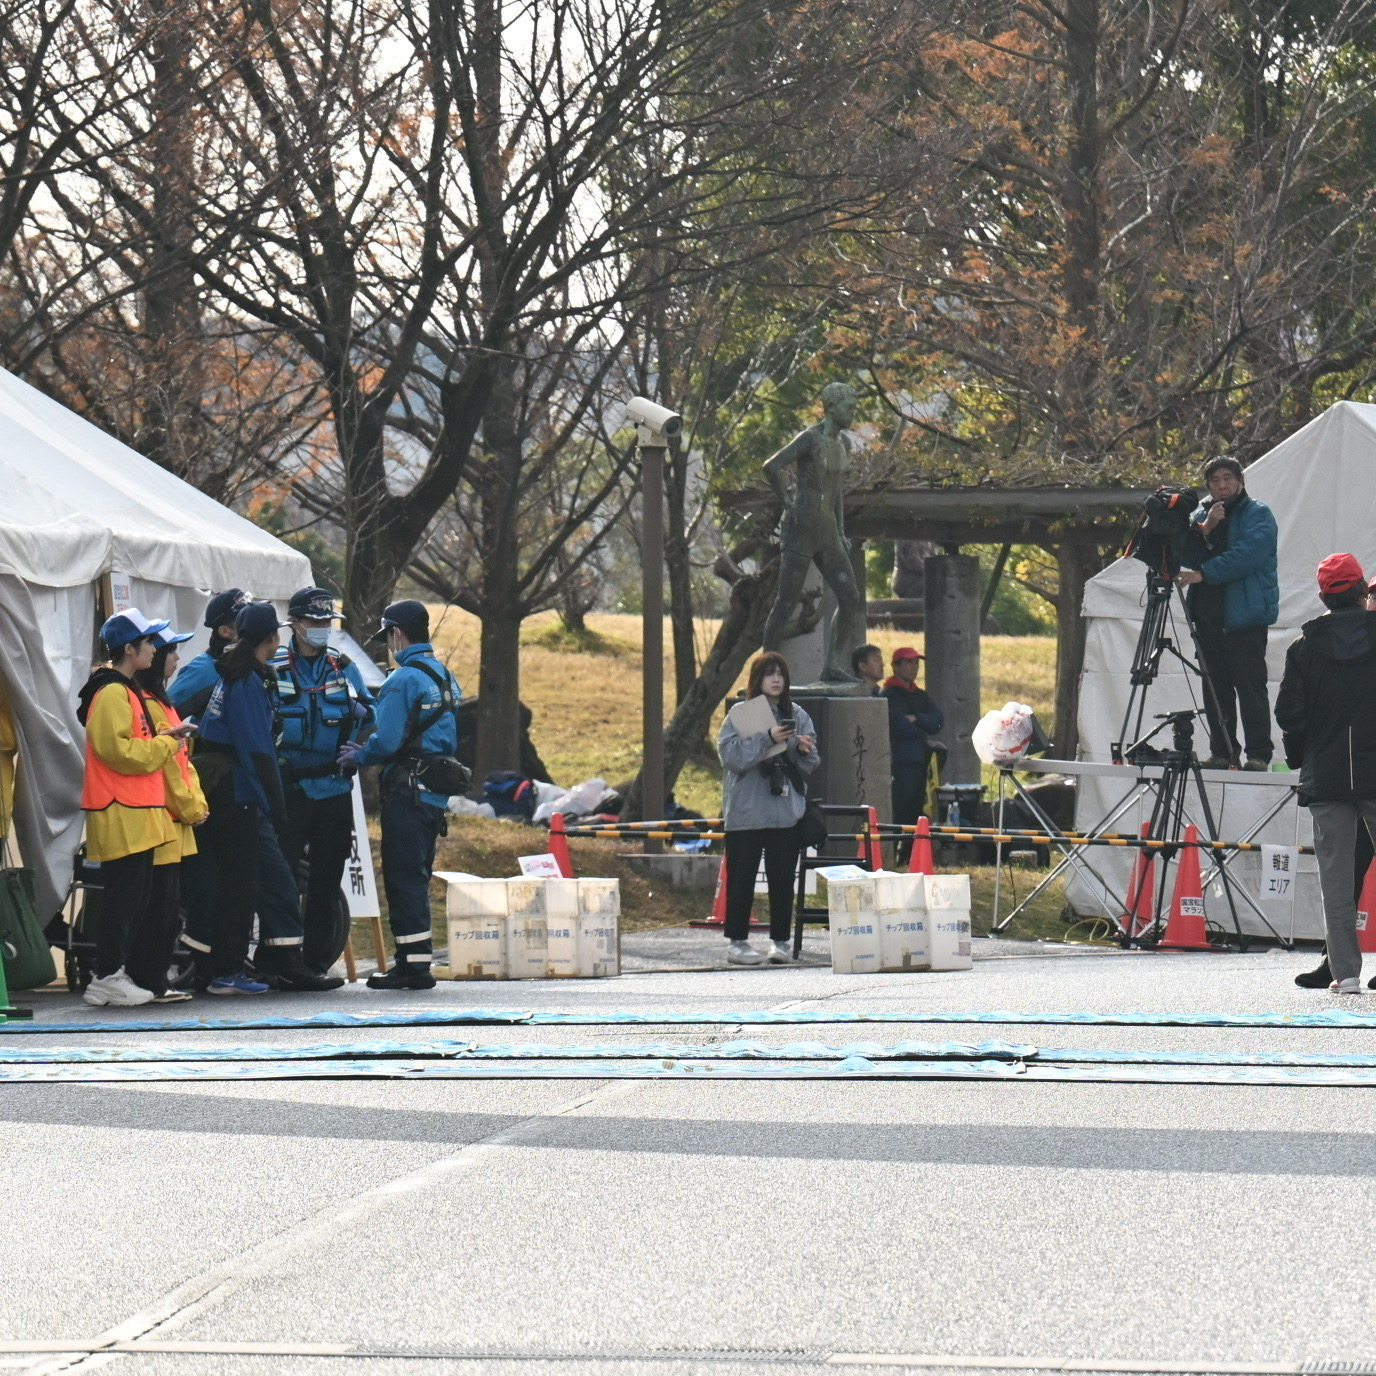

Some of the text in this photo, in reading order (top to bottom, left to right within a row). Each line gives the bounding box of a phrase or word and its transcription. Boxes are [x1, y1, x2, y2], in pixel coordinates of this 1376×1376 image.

[1269, 878, 1291, 894] エリア
[455, 930, 500, 940] チップ回収箱
